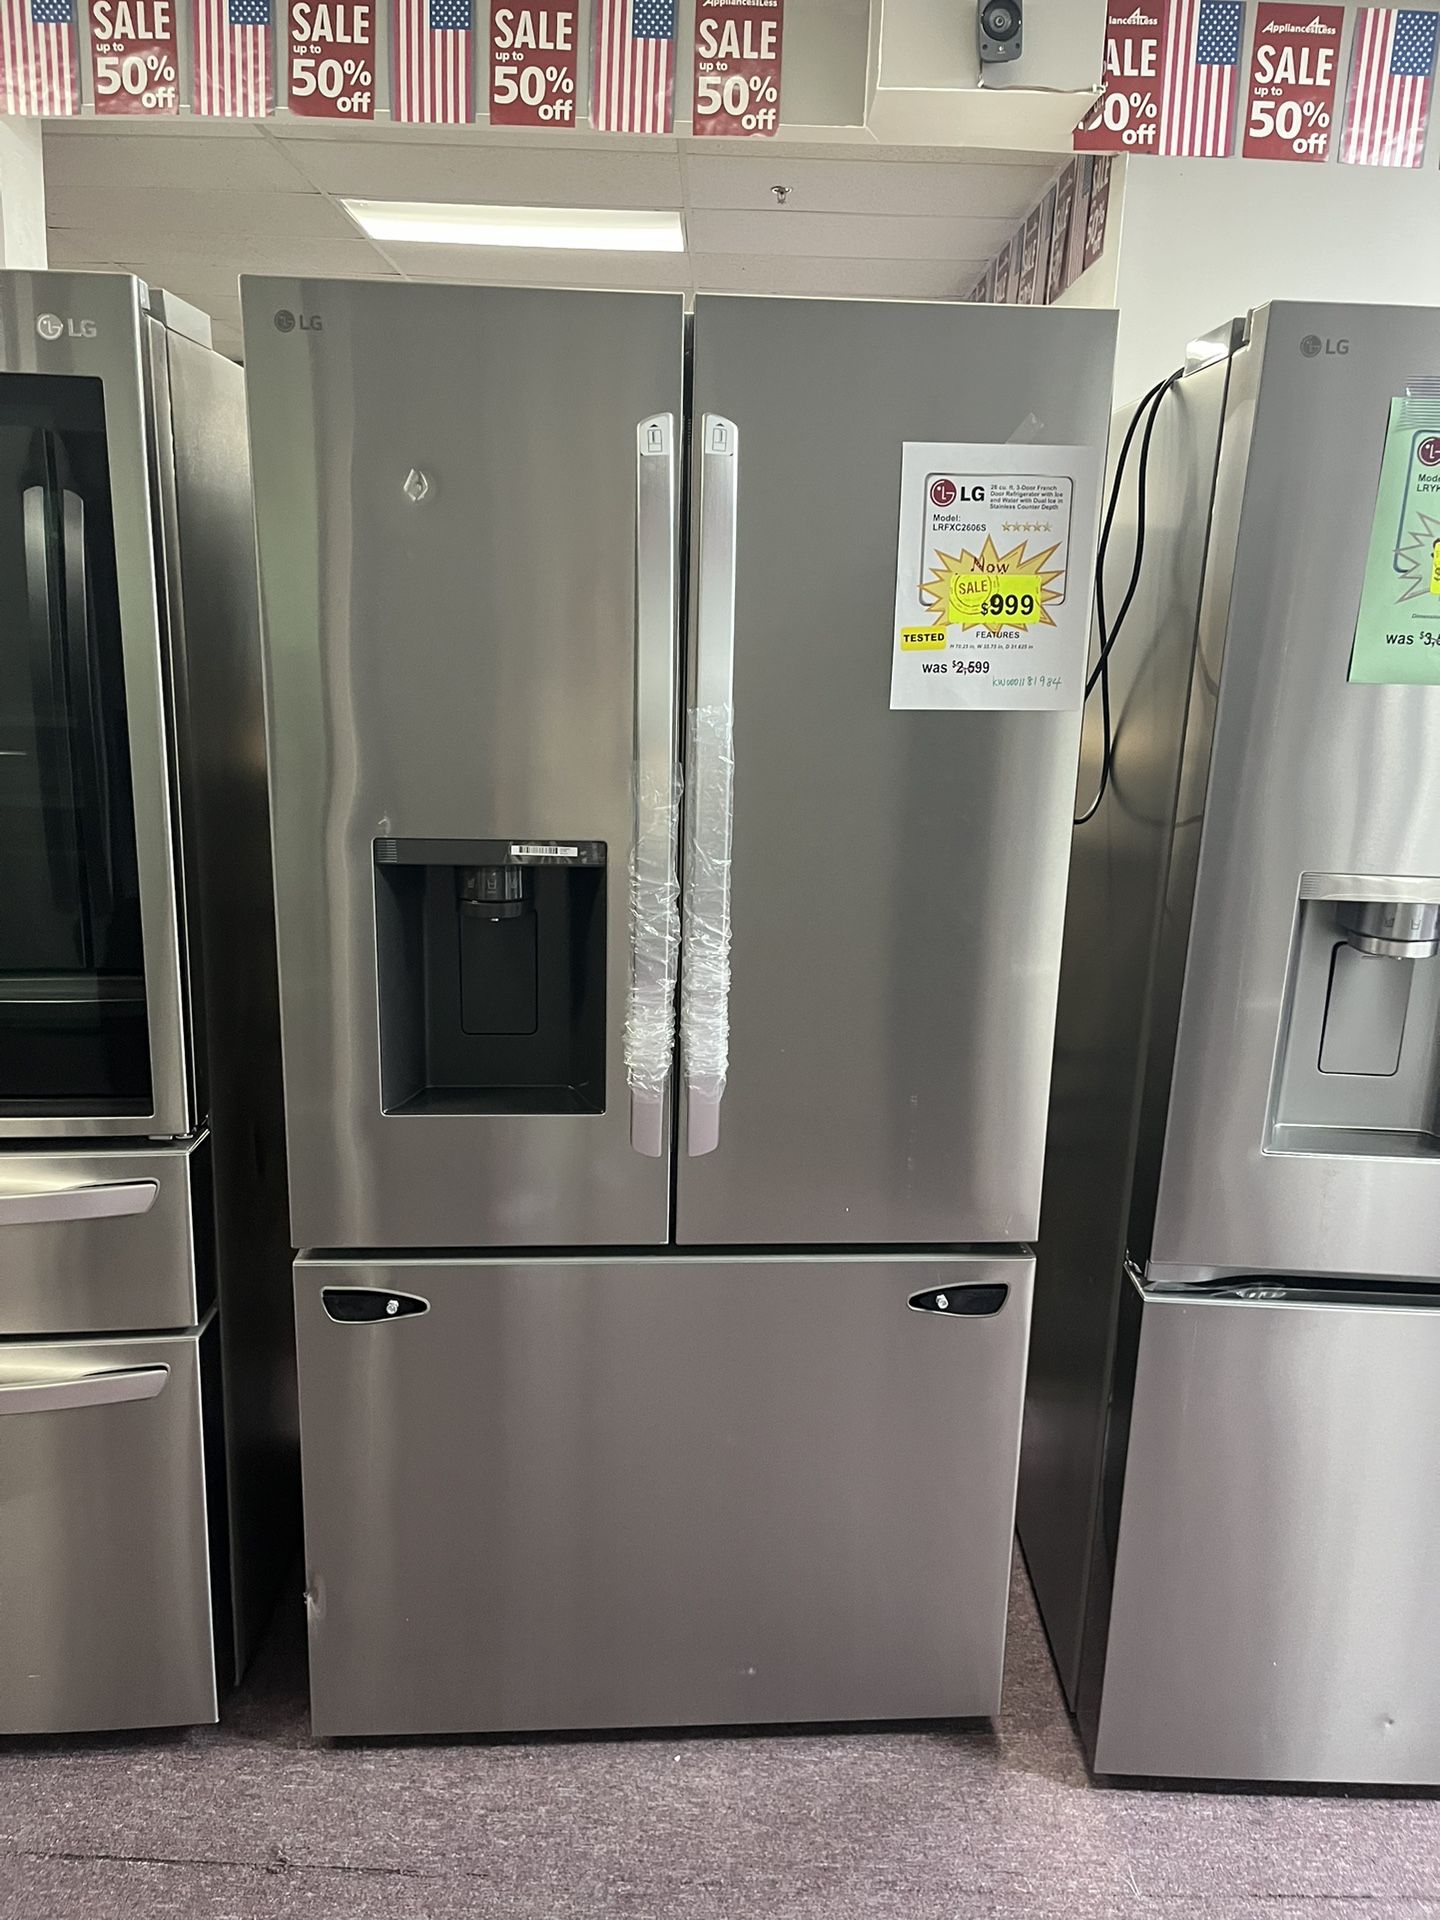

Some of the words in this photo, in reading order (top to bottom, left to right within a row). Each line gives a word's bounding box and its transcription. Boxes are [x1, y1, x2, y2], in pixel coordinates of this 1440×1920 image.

[93, 0, 171, 40] SALE
[291, 2, 370, 44] SALE
[494, 8, 573, 51] SALE
[96, 43, 111, 54] up
[112, 42, 124, 52] to
[698, 18, 778, 60] SALE
[293, 45, 308, 56] up
[309, 44, 322, 54] to
[495, 52, 510, 63] up
[512, 51, 524, 61] to
[1106, 38, 1158, 77] ALE
[96, 55, 175, 95] 50%
[699, 62, 714, 73] up
[715, 61, 728, 71] to
[1254, 44, 1335, 87] SALE
[291, 58, 372, 98] 50%
[493, 65, 574, 106] 50%
[141, 86, 175, 109] off
[336, 91, 371, 113] off
[697, 75, 778, 116] 50%
[1254, 86, 1269, 97] up
[1270, 86, 1283, 97] to
[538, 99, 573, 121] off
[741, 108, 777, 130] off
[1249, 100, 1331, 140] 50%
[1122, 124, 1157, 145] off
[1292, 132, 1328, 155] off
[68, 318, 97, 338] LG
[299, 314, 323, 332] LG
[1325, 338, 1350, 356] LG
[960, 486, 985, 502] LG
[933, 514, 961, 522] Model:
[971, 556, 1010, 573] Now
[958, 580, 988, 595] SALE
[980, 593, 1034, 616] $999
[903, 632, 945, 643] TESTED
[975, 631, 1020, 639] FEATURES
[1386, 634, 1414, 645] was
[922, 663, 948, 673] was
[952, 659, 990, 675] $2,599
